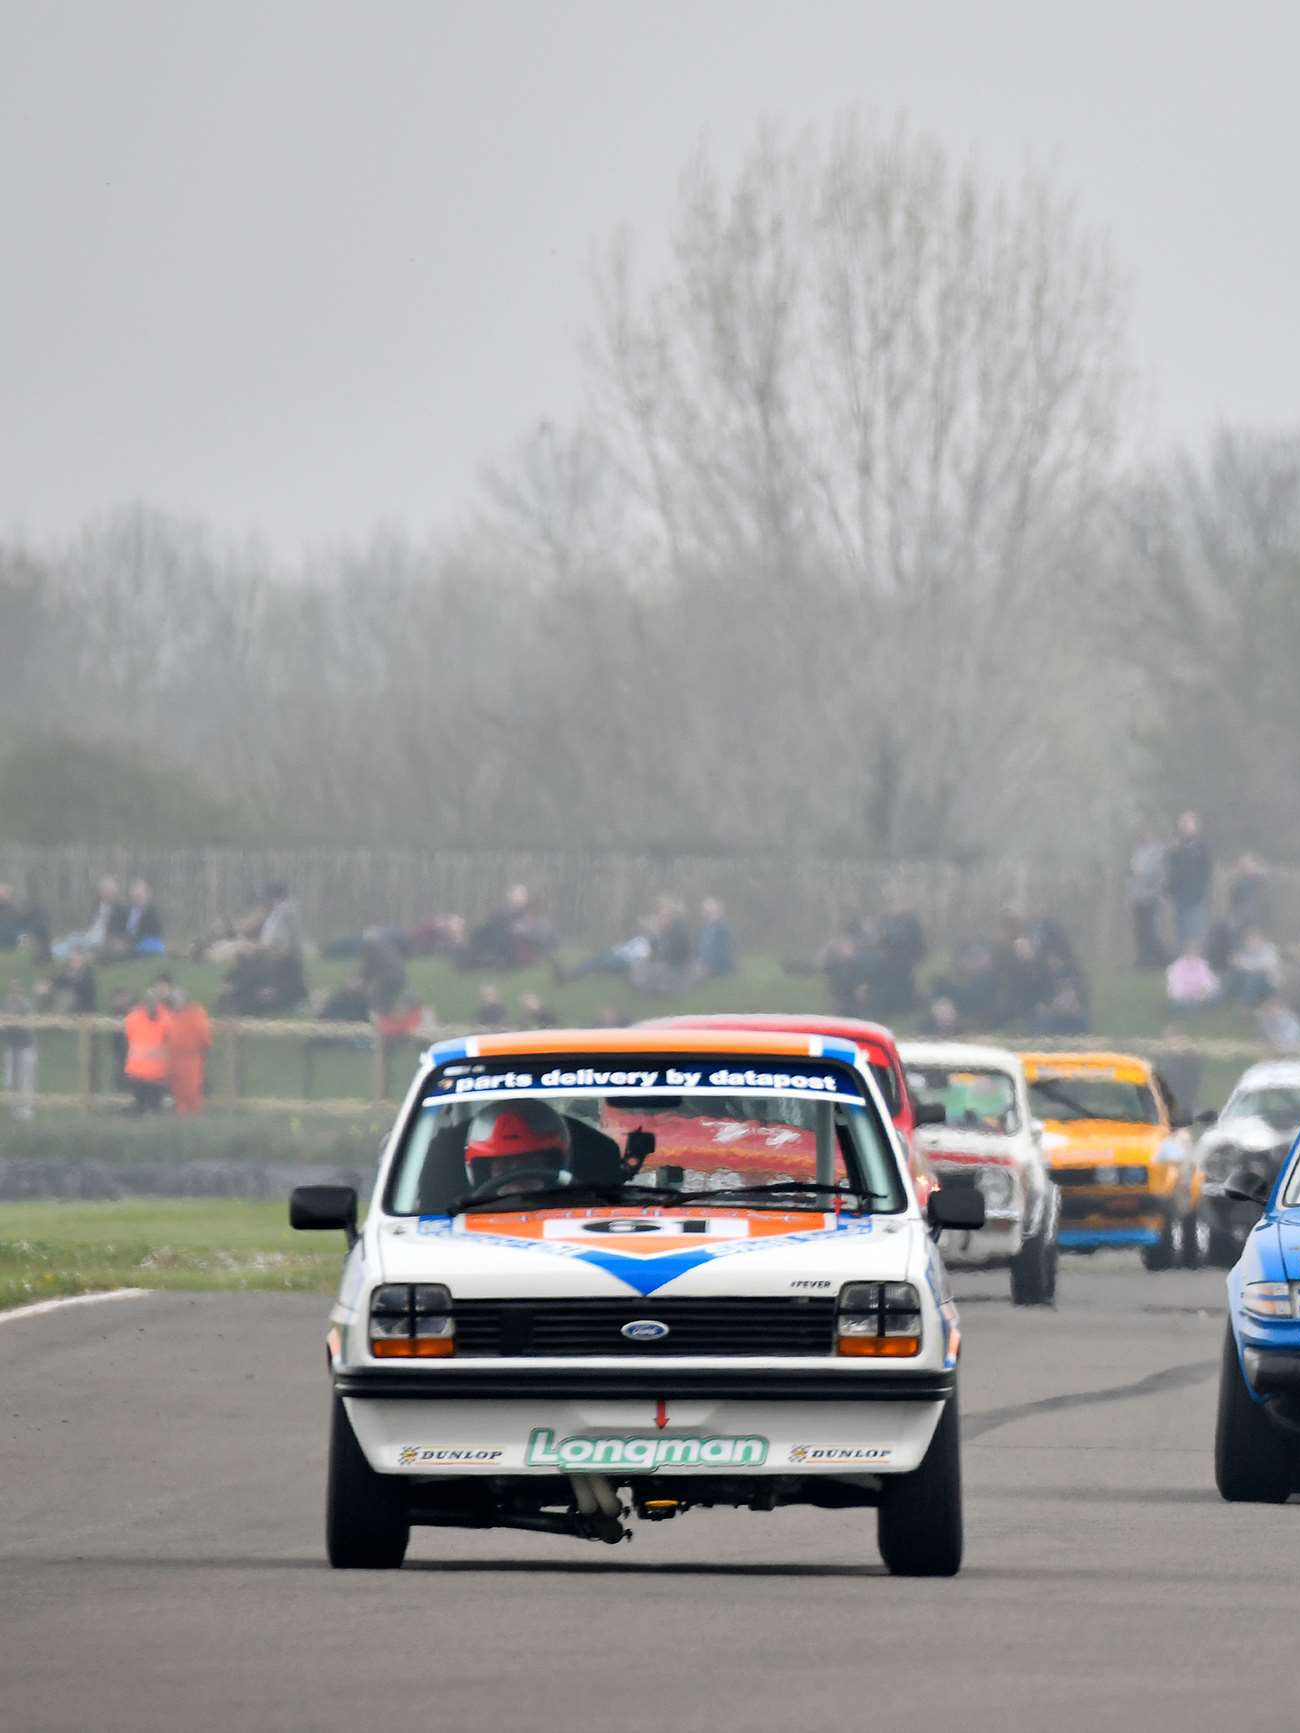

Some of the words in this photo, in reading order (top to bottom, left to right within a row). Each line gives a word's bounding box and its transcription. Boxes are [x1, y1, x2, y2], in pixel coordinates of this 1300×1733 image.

[455, 1072, 533, 1092] parts
[541, 1069, 659, 1087] delivery
[666, 1069, 701, 1087] by
[709, 1070, 836, 1091] datapost
[421, 1450, 503, 1460] DUNLOP
[528, 1430, 768, 1471] Longman
[811, 1449, 892, 1459] DUNLOP
